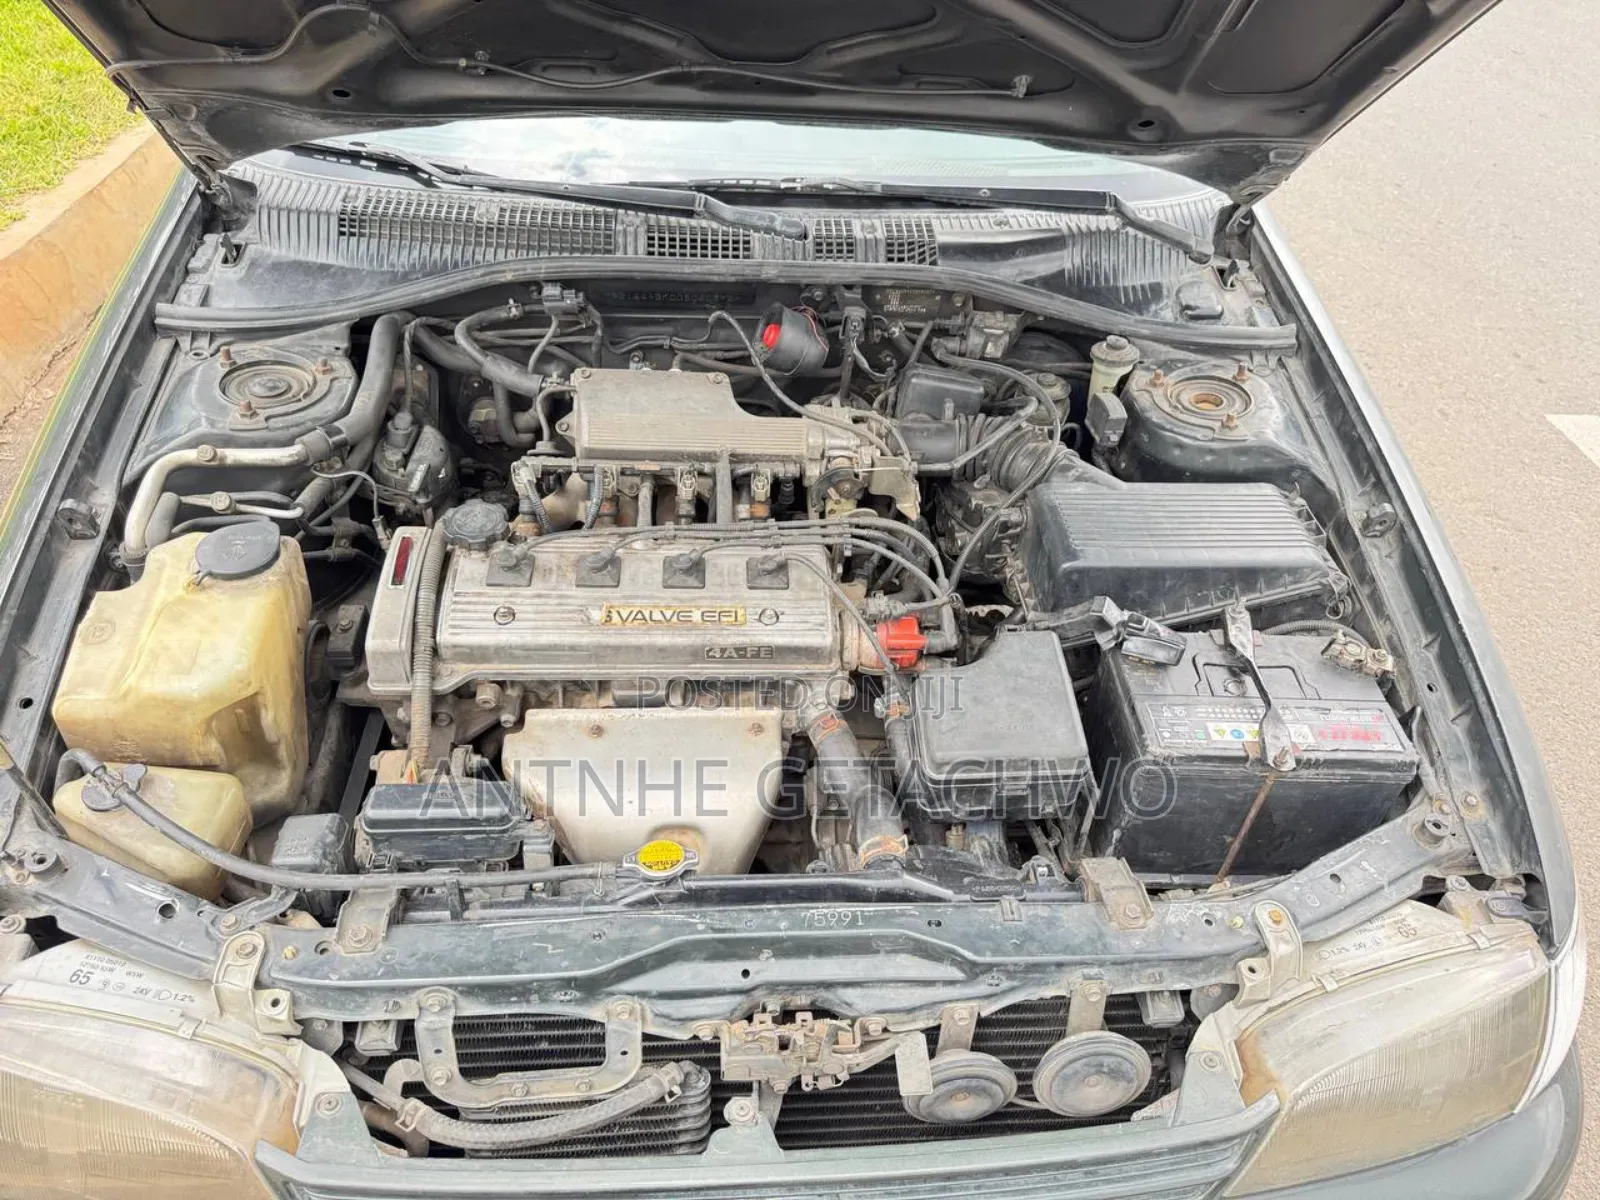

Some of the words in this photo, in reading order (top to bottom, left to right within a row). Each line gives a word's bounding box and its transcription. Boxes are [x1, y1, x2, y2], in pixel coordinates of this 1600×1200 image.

[616, 609, 693, 623] VALVE
[701, 609, 739, 623] EFI
[708, 646, 772, 658] 4A-FE
[799, 909, 864, 928] 75991
[69, 969, 95, 985] 65
